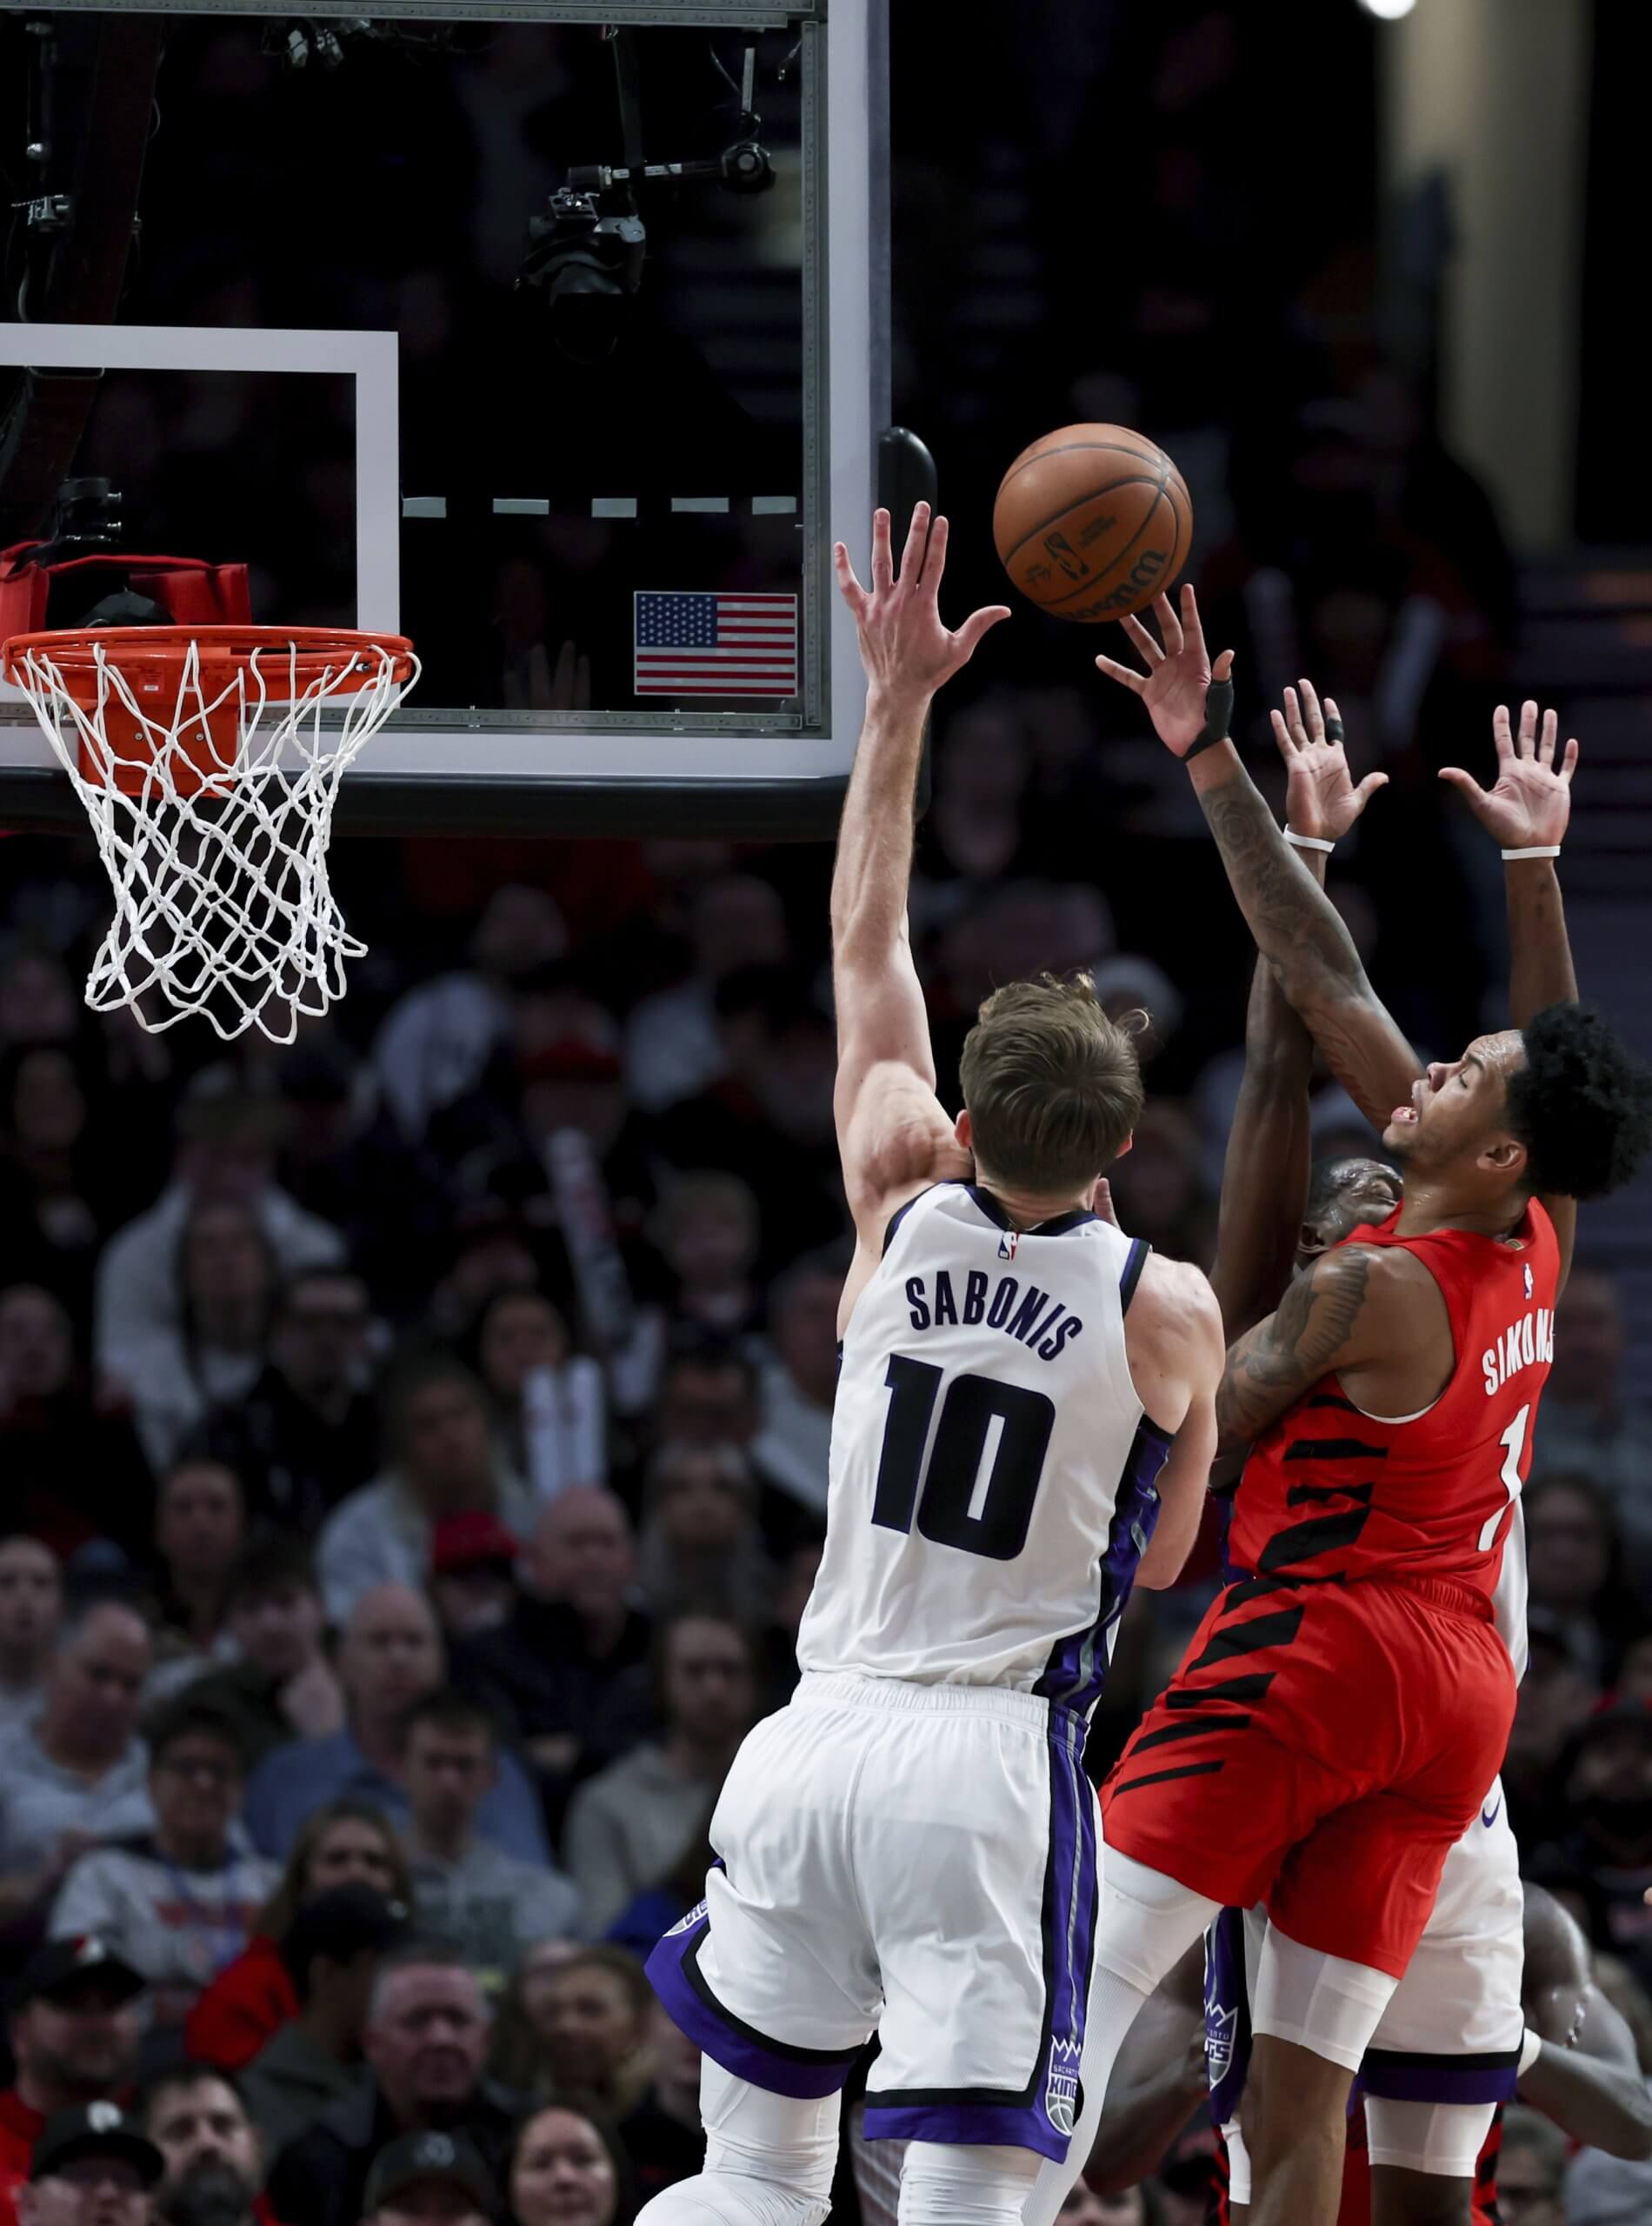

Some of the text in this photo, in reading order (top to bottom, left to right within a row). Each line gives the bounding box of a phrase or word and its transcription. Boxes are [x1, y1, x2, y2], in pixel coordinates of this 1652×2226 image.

[905, 1270, 1083, 1362] SABONIS
[870, 1353, 1056, 1562] 10
[1477, 1403, 1531, 1553] 1
